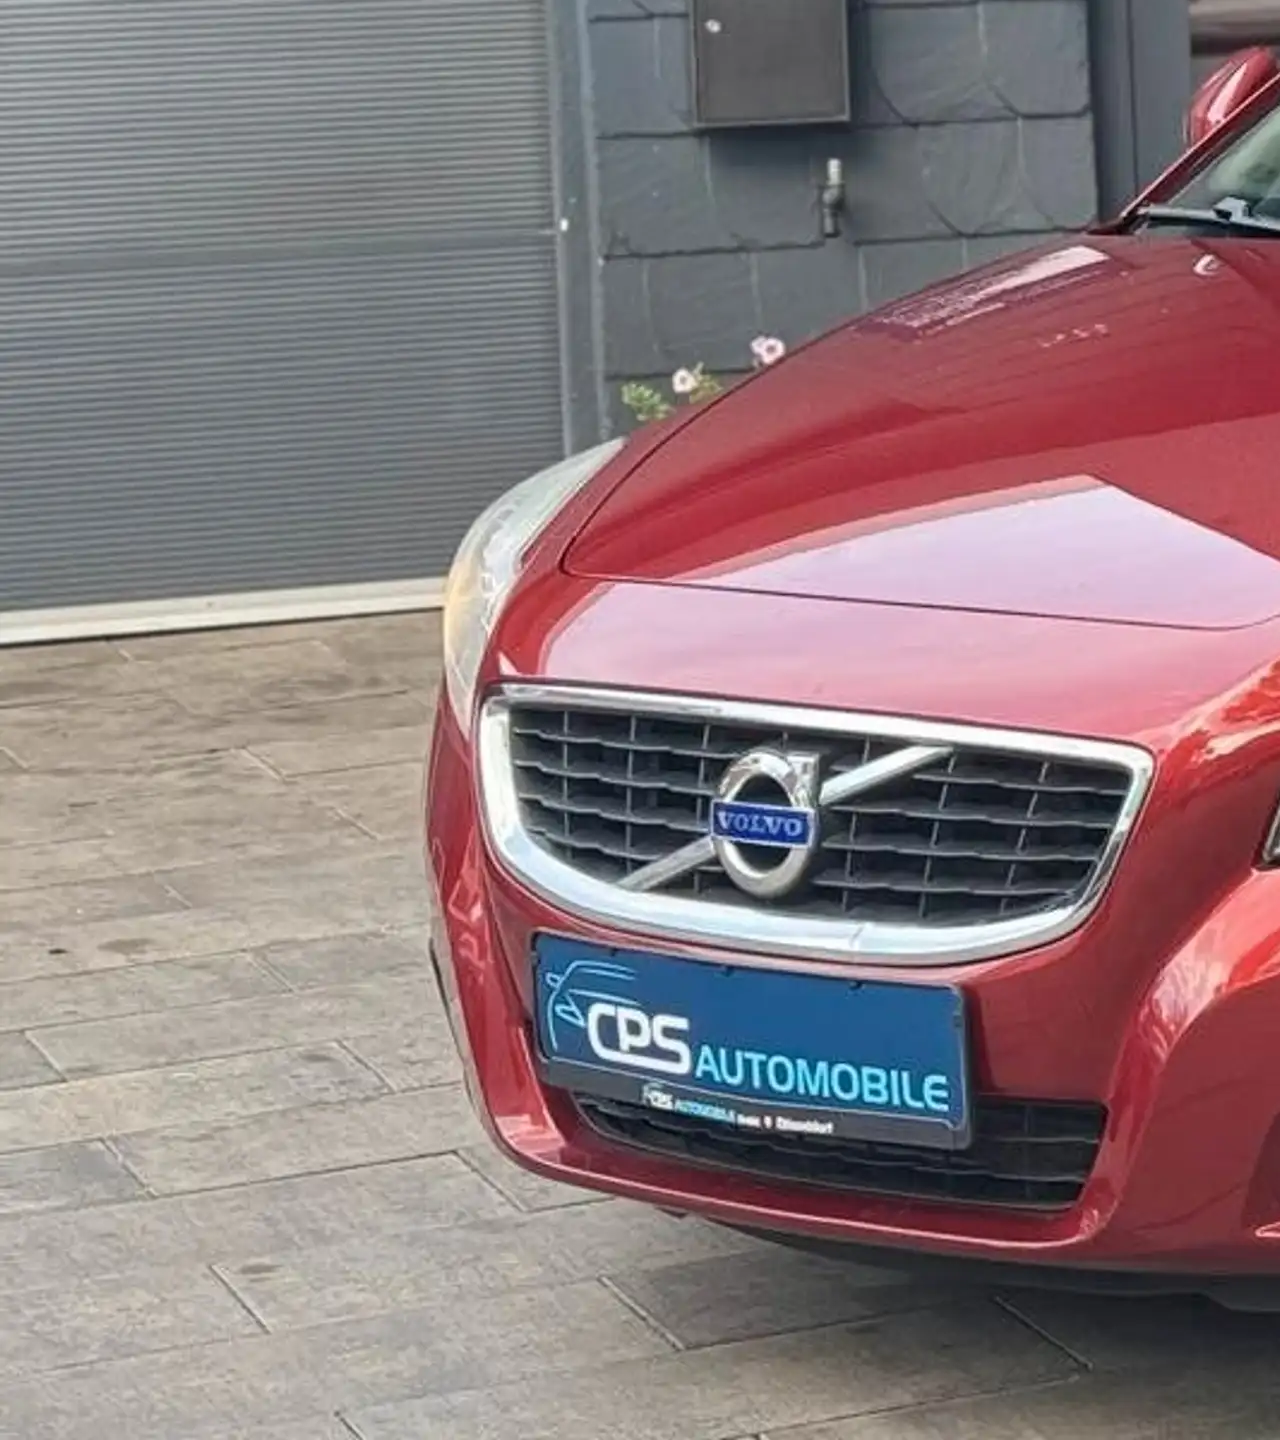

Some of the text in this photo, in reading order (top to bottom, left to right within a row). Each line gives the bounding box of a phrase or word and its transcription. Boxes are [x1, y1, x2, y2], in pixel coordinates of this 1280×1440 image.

[716, 811, 803, 837] VOLVO
[588, 1001, 950, 1113] CPS AUTOMOBILE
